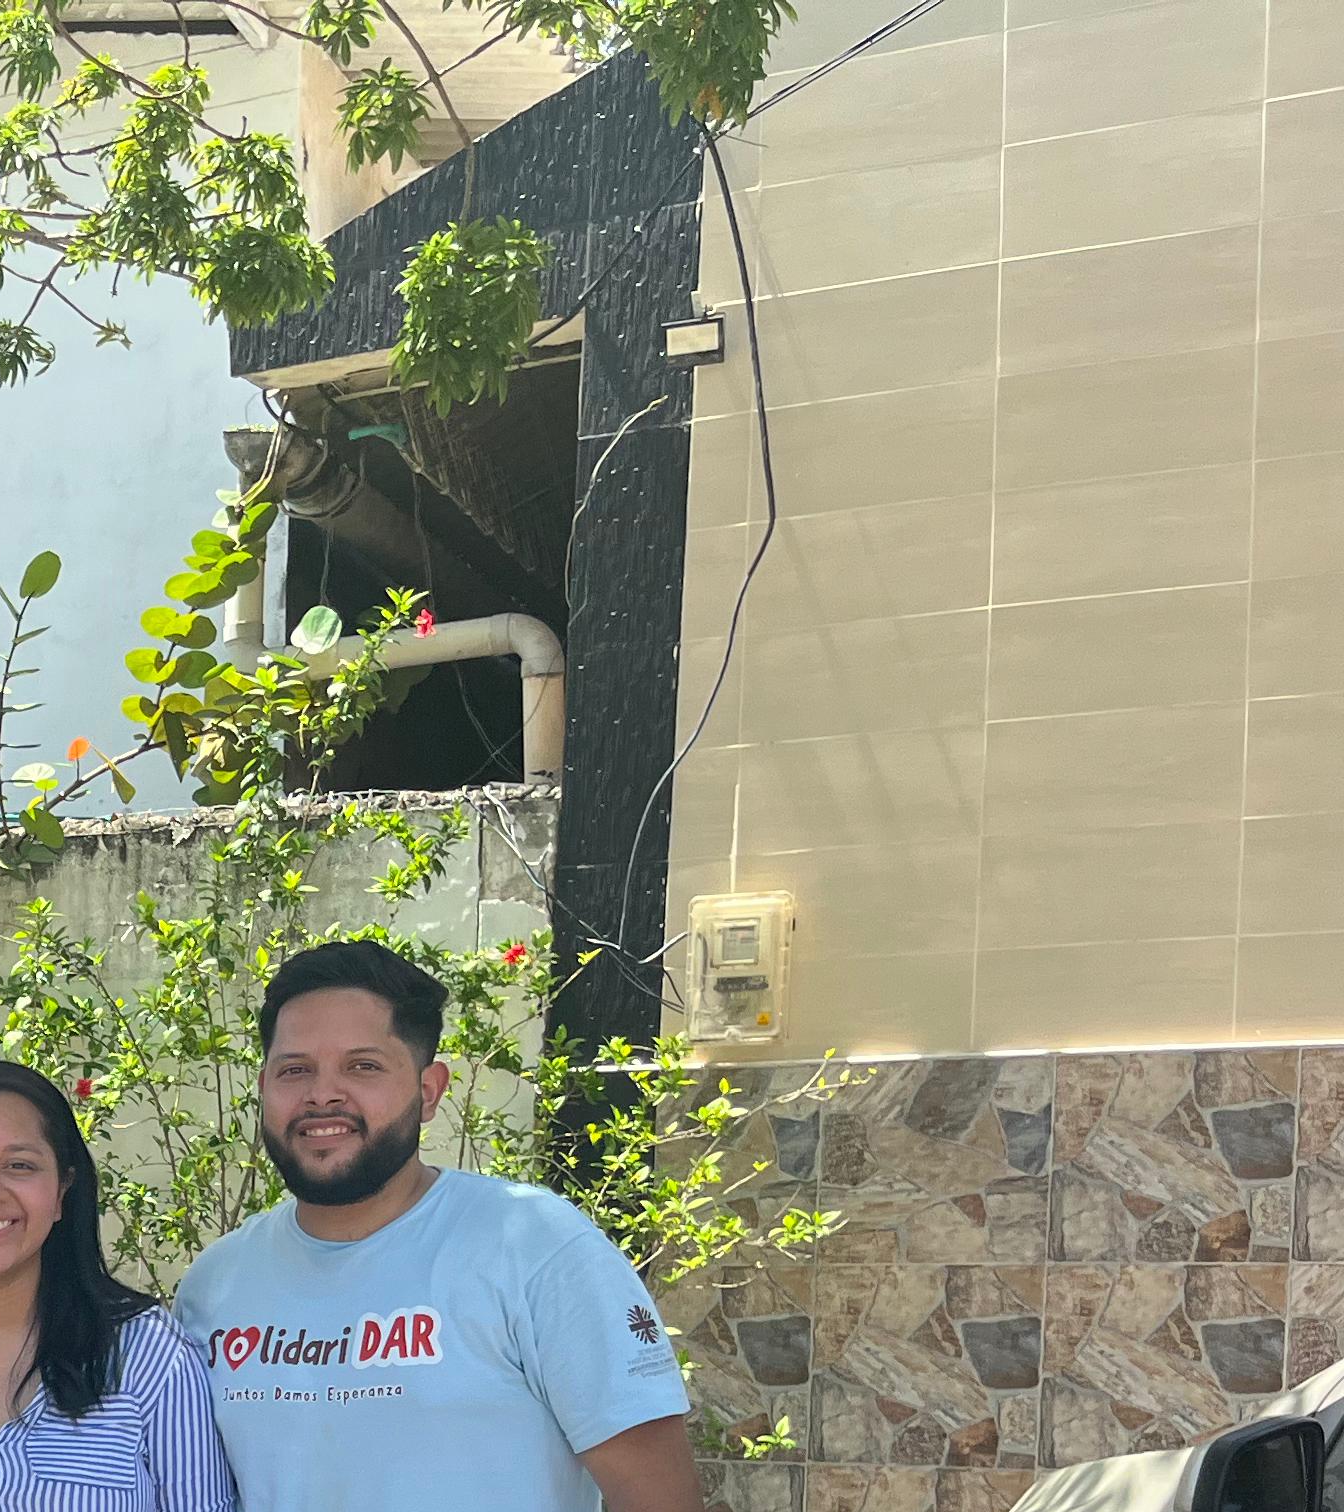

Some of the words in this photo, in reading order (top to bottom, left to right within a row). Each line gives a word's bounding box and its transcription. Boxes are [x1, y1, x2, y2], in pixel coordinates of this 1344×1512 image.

[358, 1312, 436, 1362] DAR
[222, 1387, 265, 1402] Juntos
[274, 1386, 318, 1402] Damos
[327, 1385, 403, 1405] Esperanza
